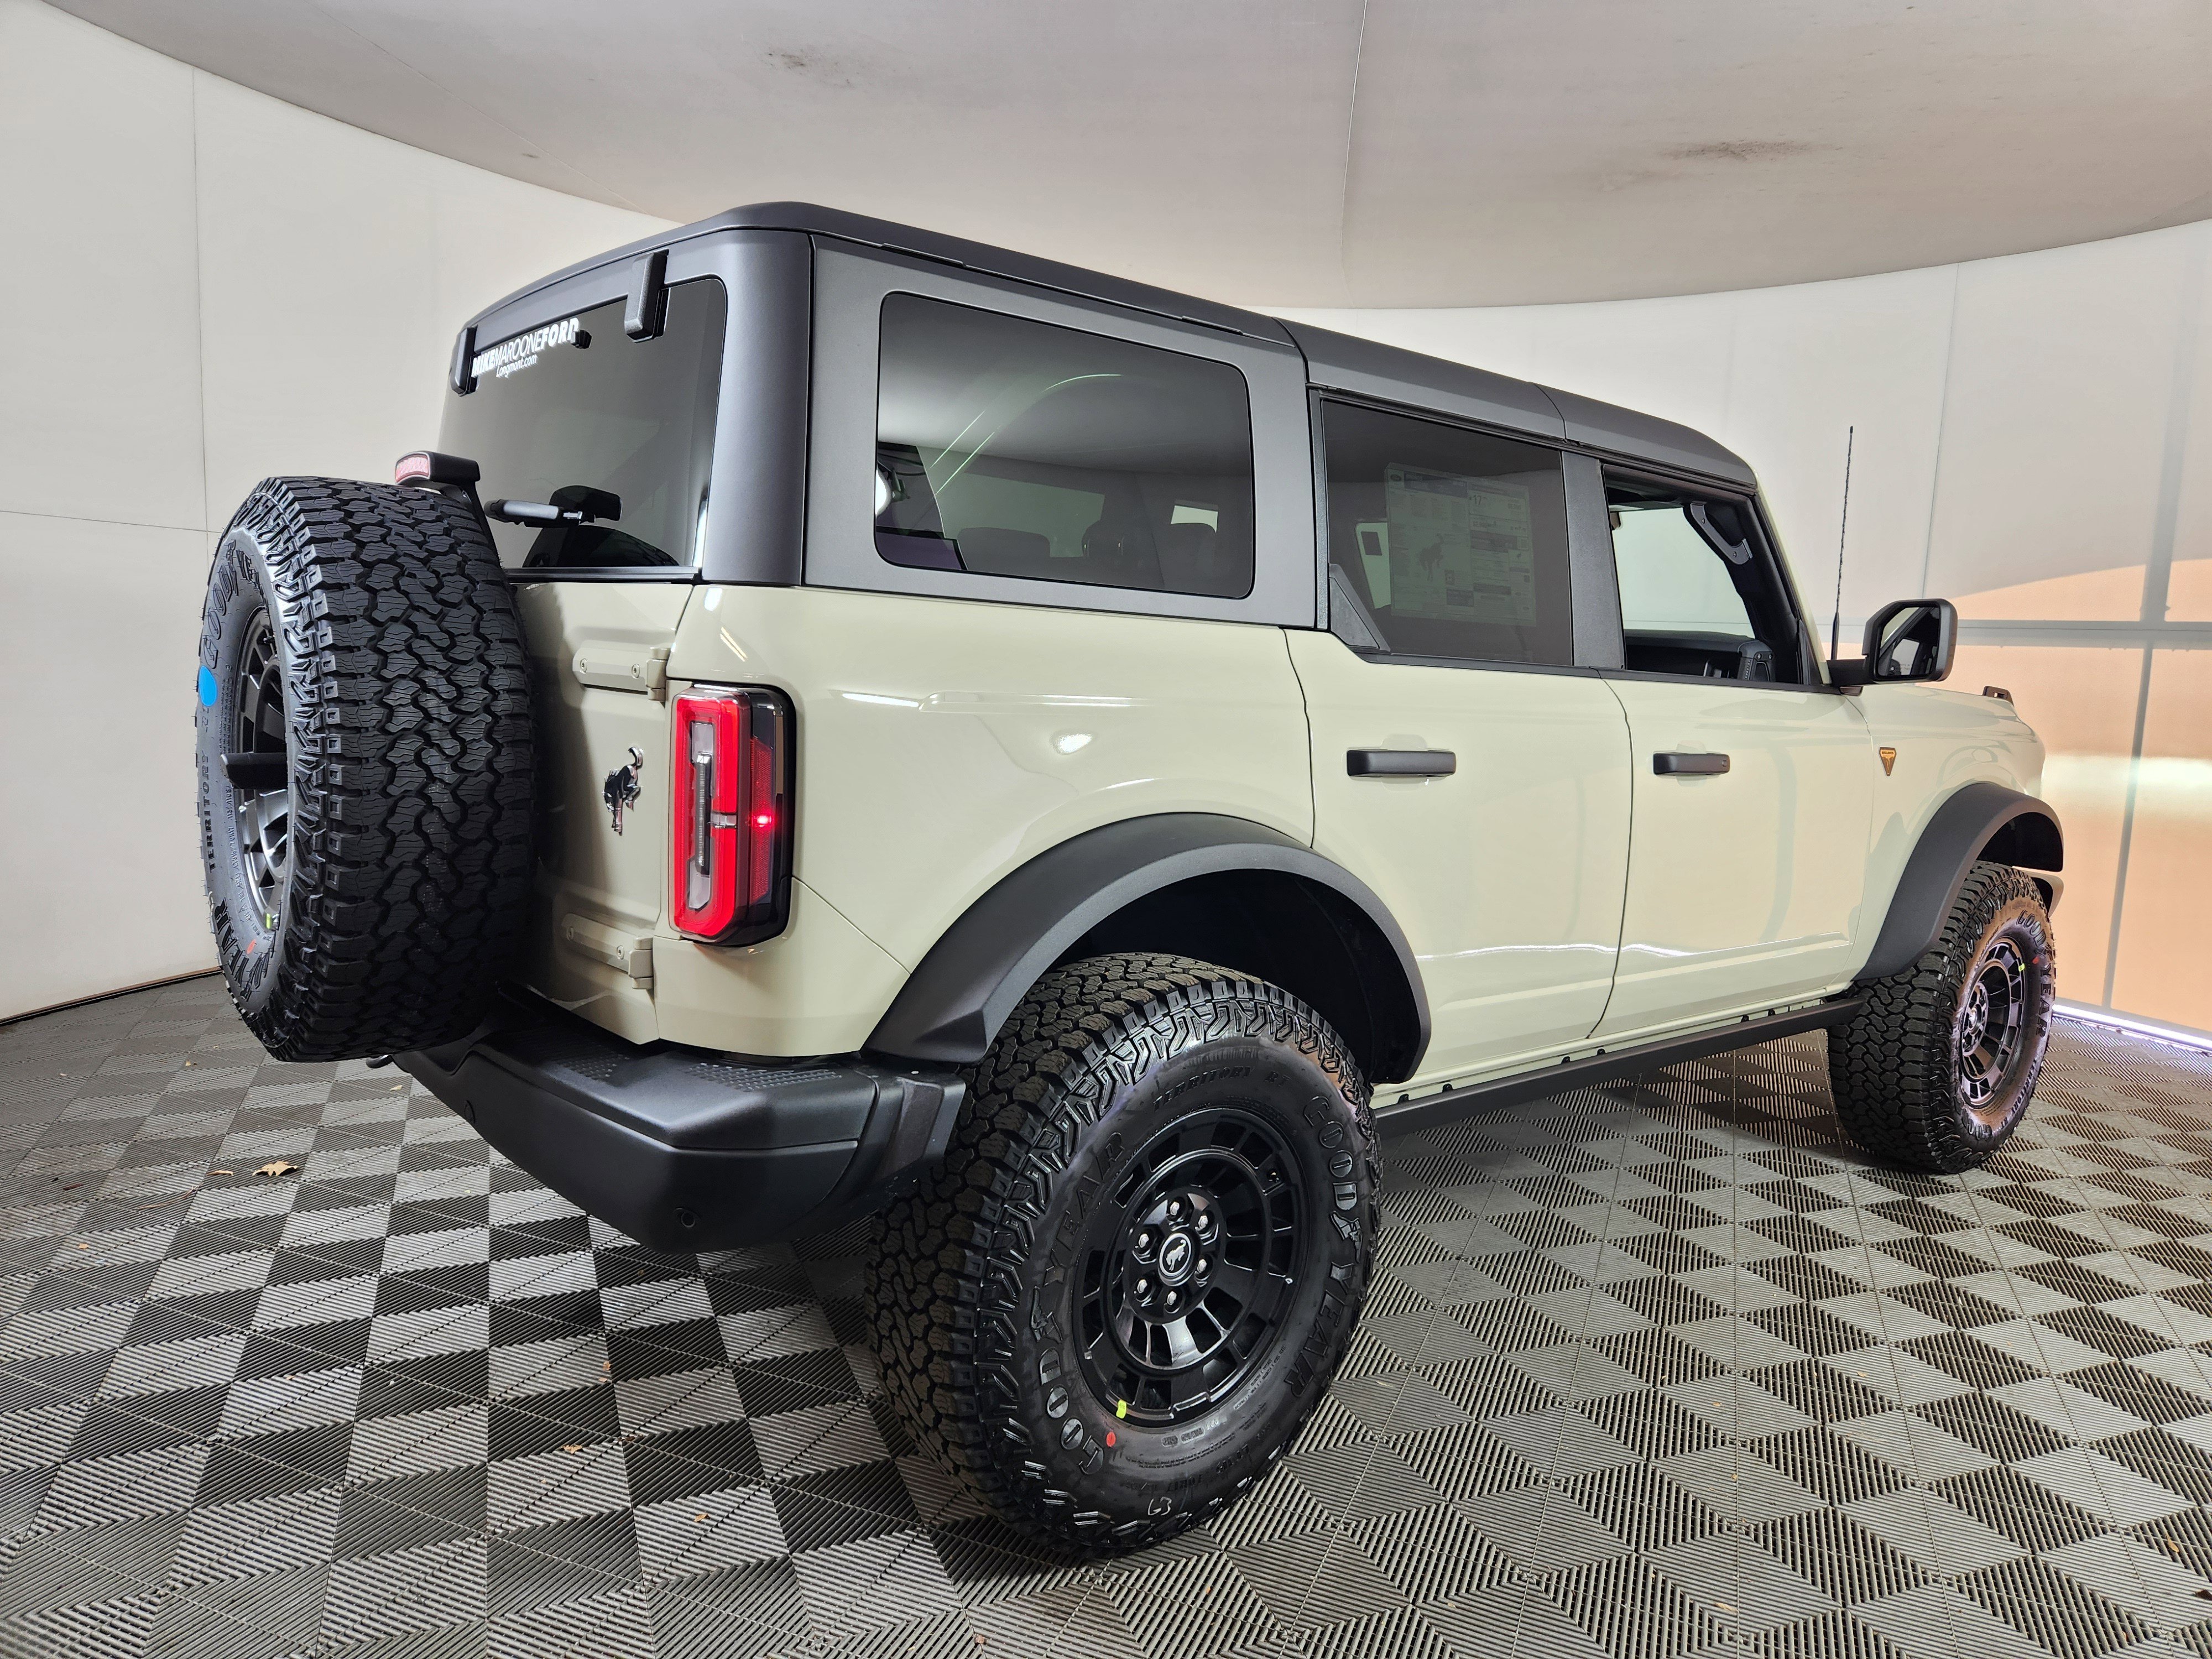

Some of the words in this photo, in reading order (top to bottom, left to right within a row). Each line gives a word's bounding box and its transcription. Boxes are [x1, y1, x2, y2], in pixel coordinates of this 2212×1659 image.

[496, 354, 538, 378] Longmont.com
[1153, 1065, 1255, 1113] TERRITORY
[1284, 1095, 1363, 1397] GOODYEAR
